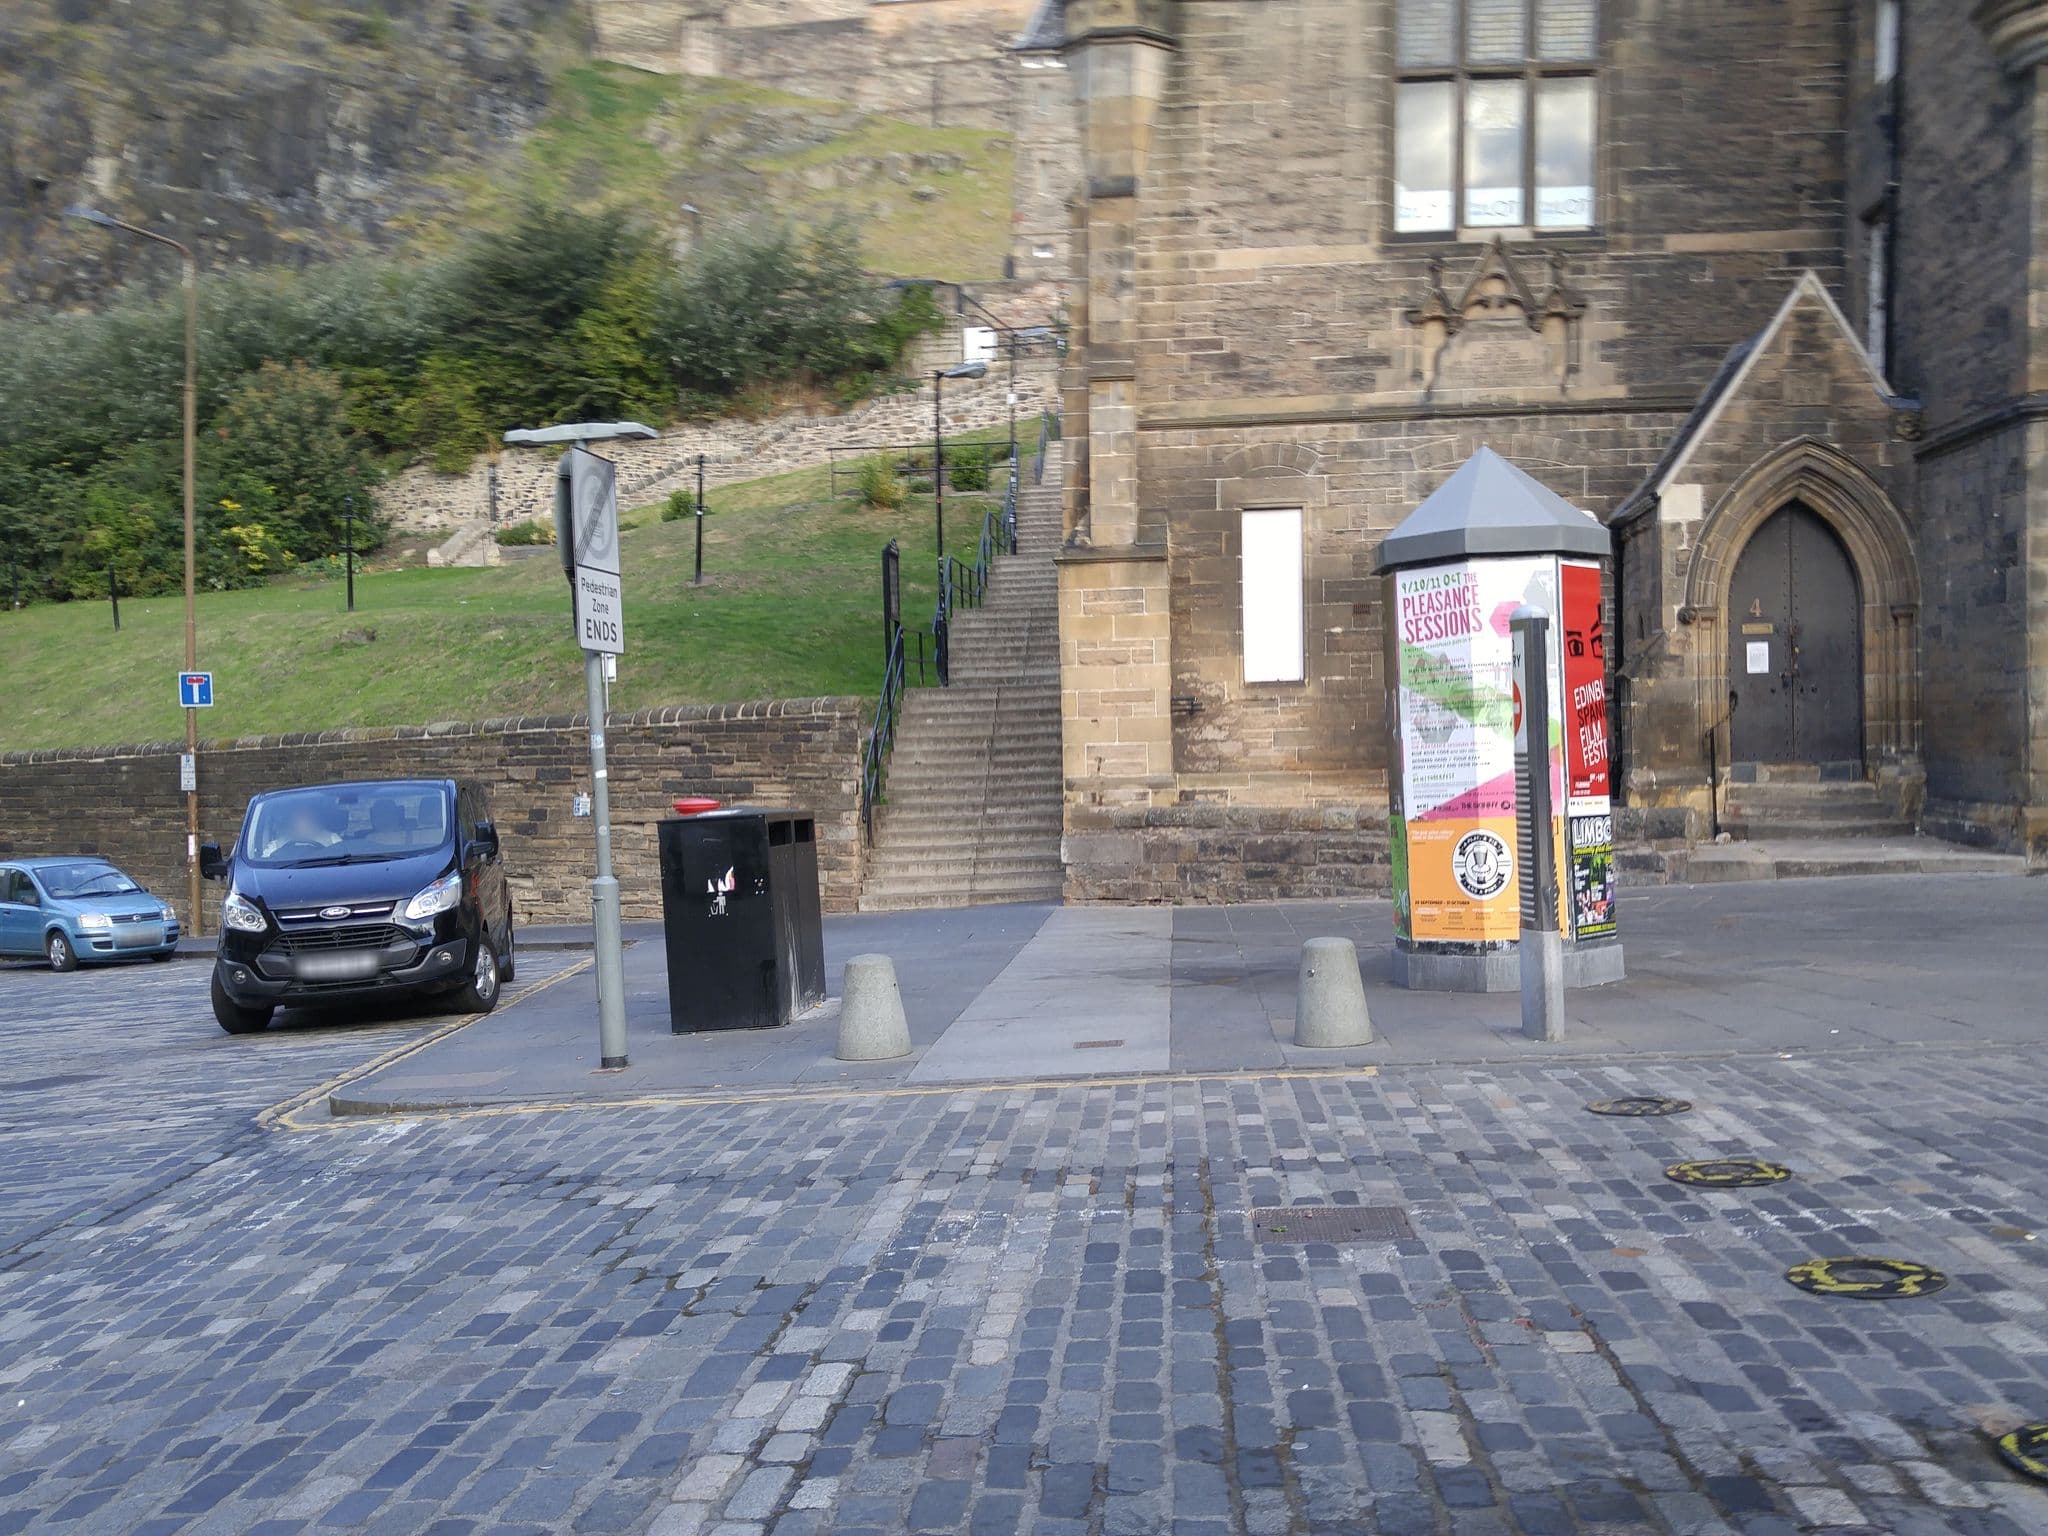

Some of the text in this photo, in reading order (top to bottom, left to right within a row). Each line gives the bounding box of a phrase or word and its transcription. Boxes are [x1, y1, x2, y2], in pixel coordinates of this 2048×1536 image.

[581, 577, 618, 598] Pedestrian
[592, 598, 609, 615] Zone
[1402, 584, 1480, 618] PLEASANCE
[1750, 597, 1761, 617] 4
[586, 618, 617, 643] ENDS
[1404, 607, 1483, 645] SESSIONS
[1579, 719, 1602, 748] FILM
